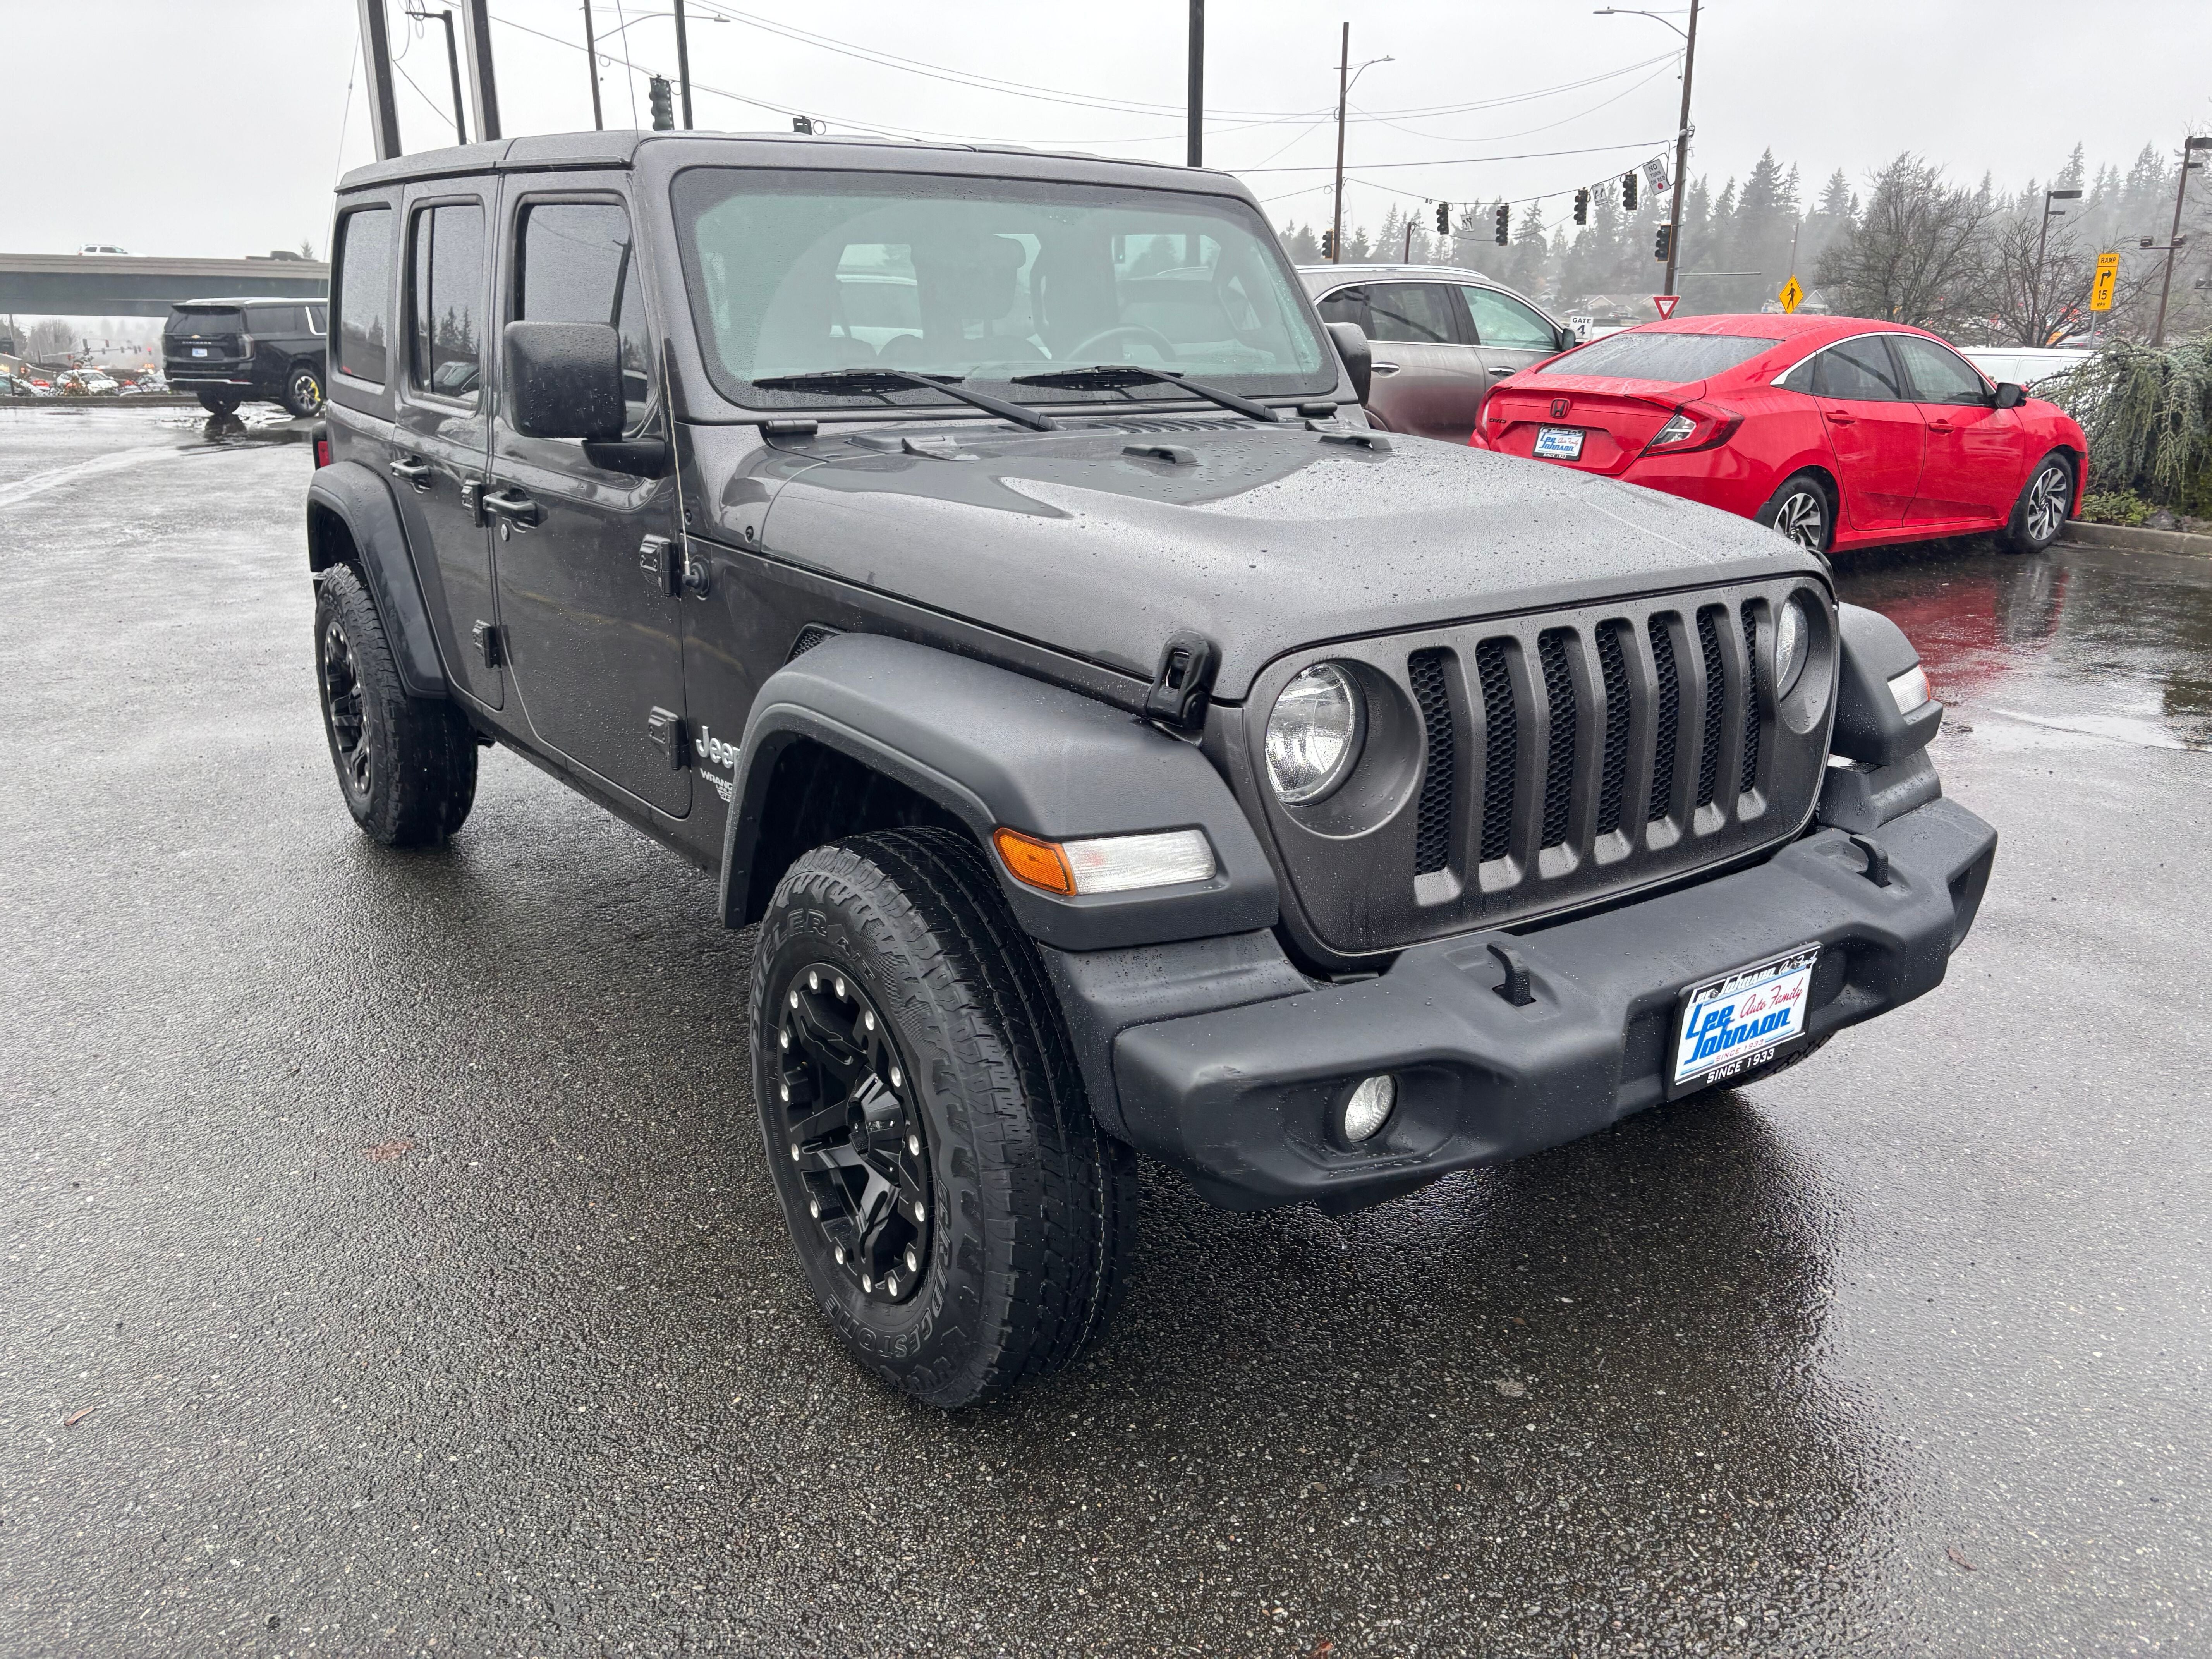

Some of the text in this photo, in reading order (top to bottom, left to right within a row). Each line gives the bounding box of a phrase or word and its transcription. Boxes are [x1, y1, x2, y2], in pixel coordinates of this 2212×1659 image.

[1648, 164, 1657, 172] NO
[2099, 290, 2107, 300] 15
[1577, 325, 1585, 336] 4
[1539, 441, 1574, 452] Johnson
[1540, 432, 1556, 443] Lee
[749, 908, 827, 1053] DUELER
[1719, 967, 1776, 996] Johnson
[1740, 977, 1803, 1018] Auto Family
[1685, 1003, 1735, 1039] Lee
[1684, 1007, 1791, 1065] Johnson
[1716, 1039, 1764, 1062] SINCE 1933
[1707, 1048, 1775, 1084] SINCE 1933
[825, 1170, 952, 1358] BRIDGESTONE
